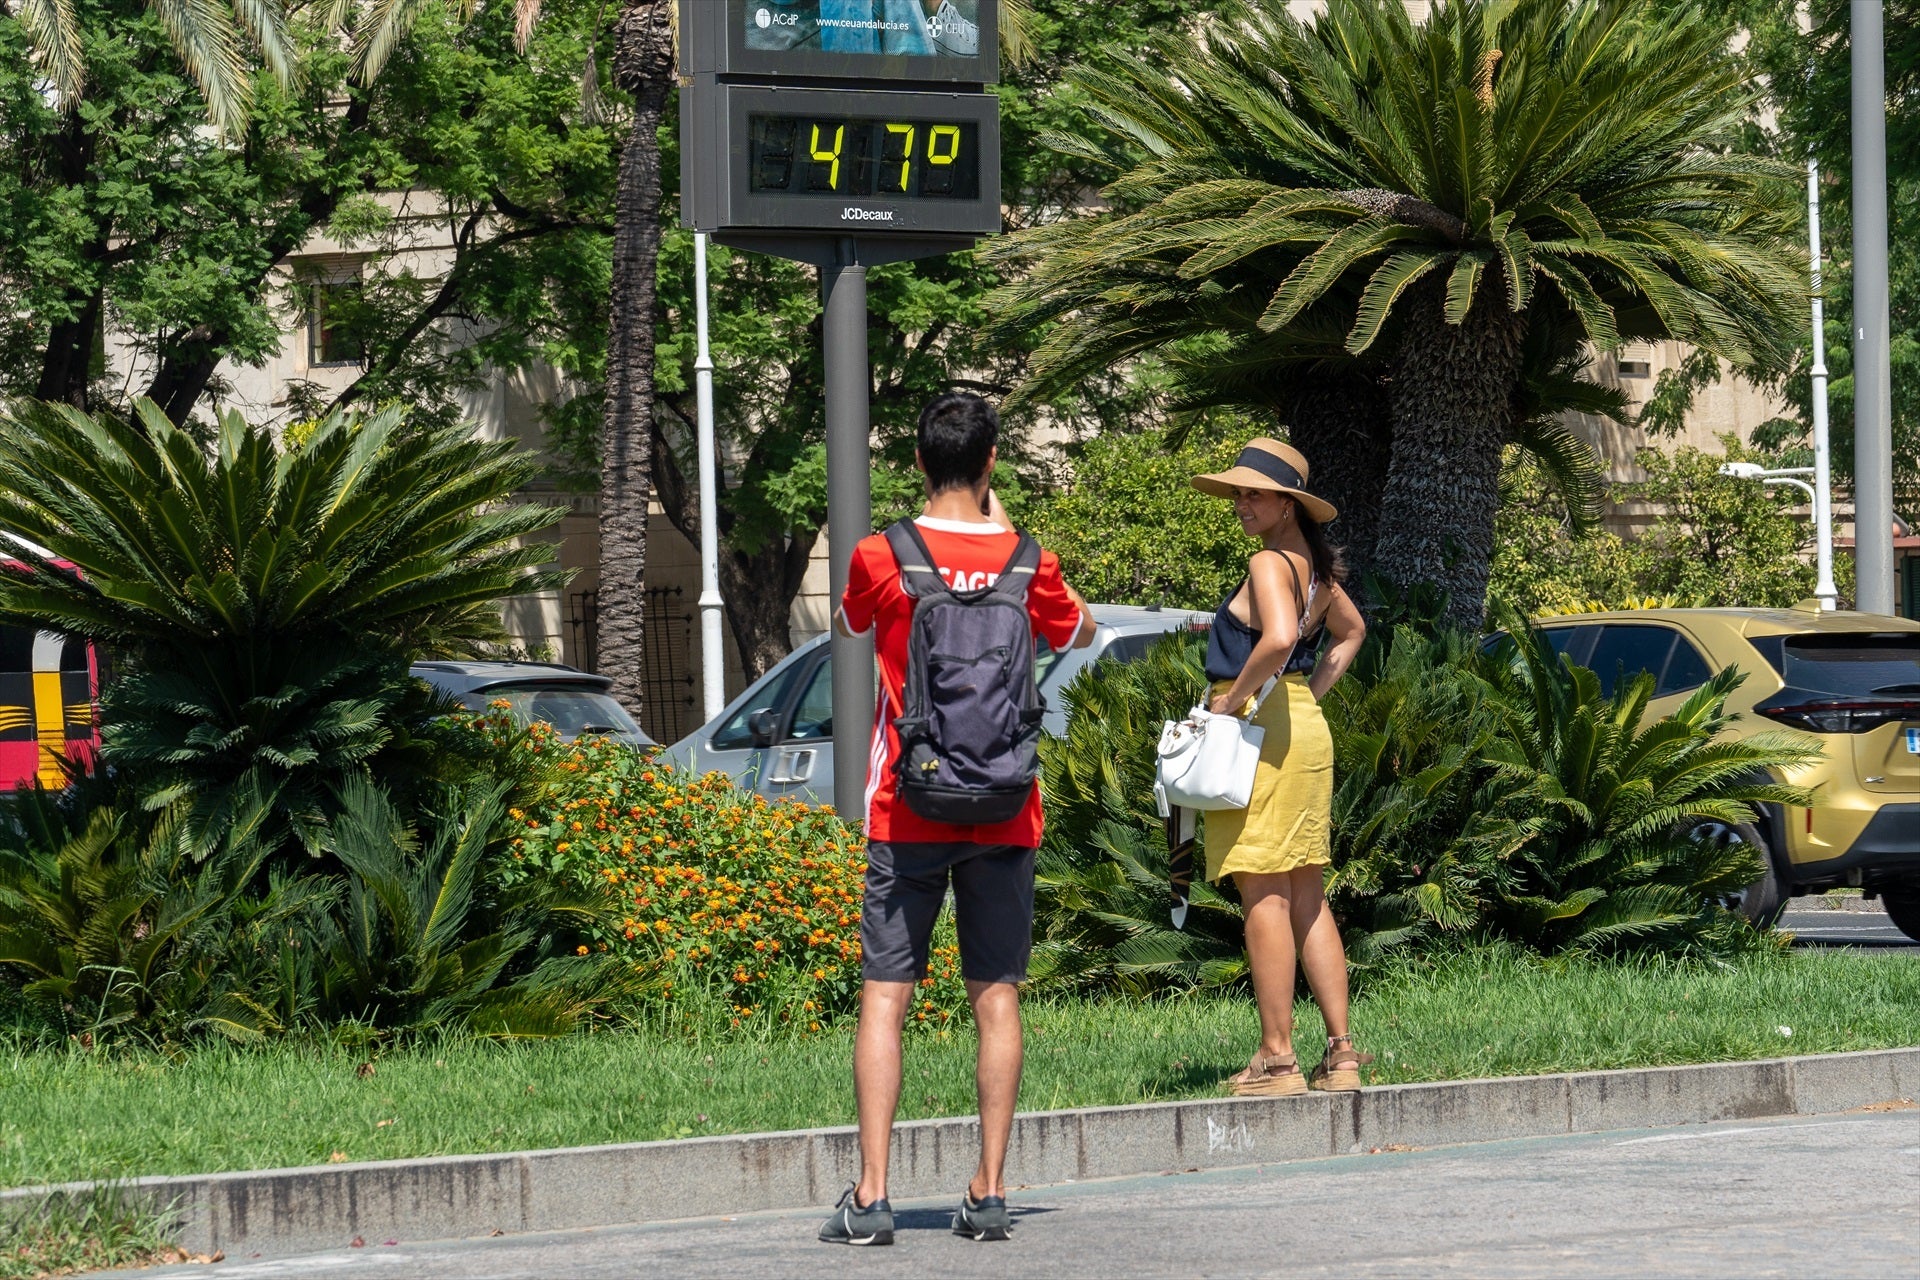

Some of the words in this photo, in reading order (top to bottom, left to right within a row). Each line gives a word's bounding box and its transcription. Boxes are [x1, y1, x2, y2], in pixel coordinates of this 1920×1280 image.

[771, 13, 799, 26] ACdP
[815, 18, 909, 31] www.ceuandalucia.es
[945, 23, 965, 34] CEU
[840, 207, 893, 221] JCDecaux
